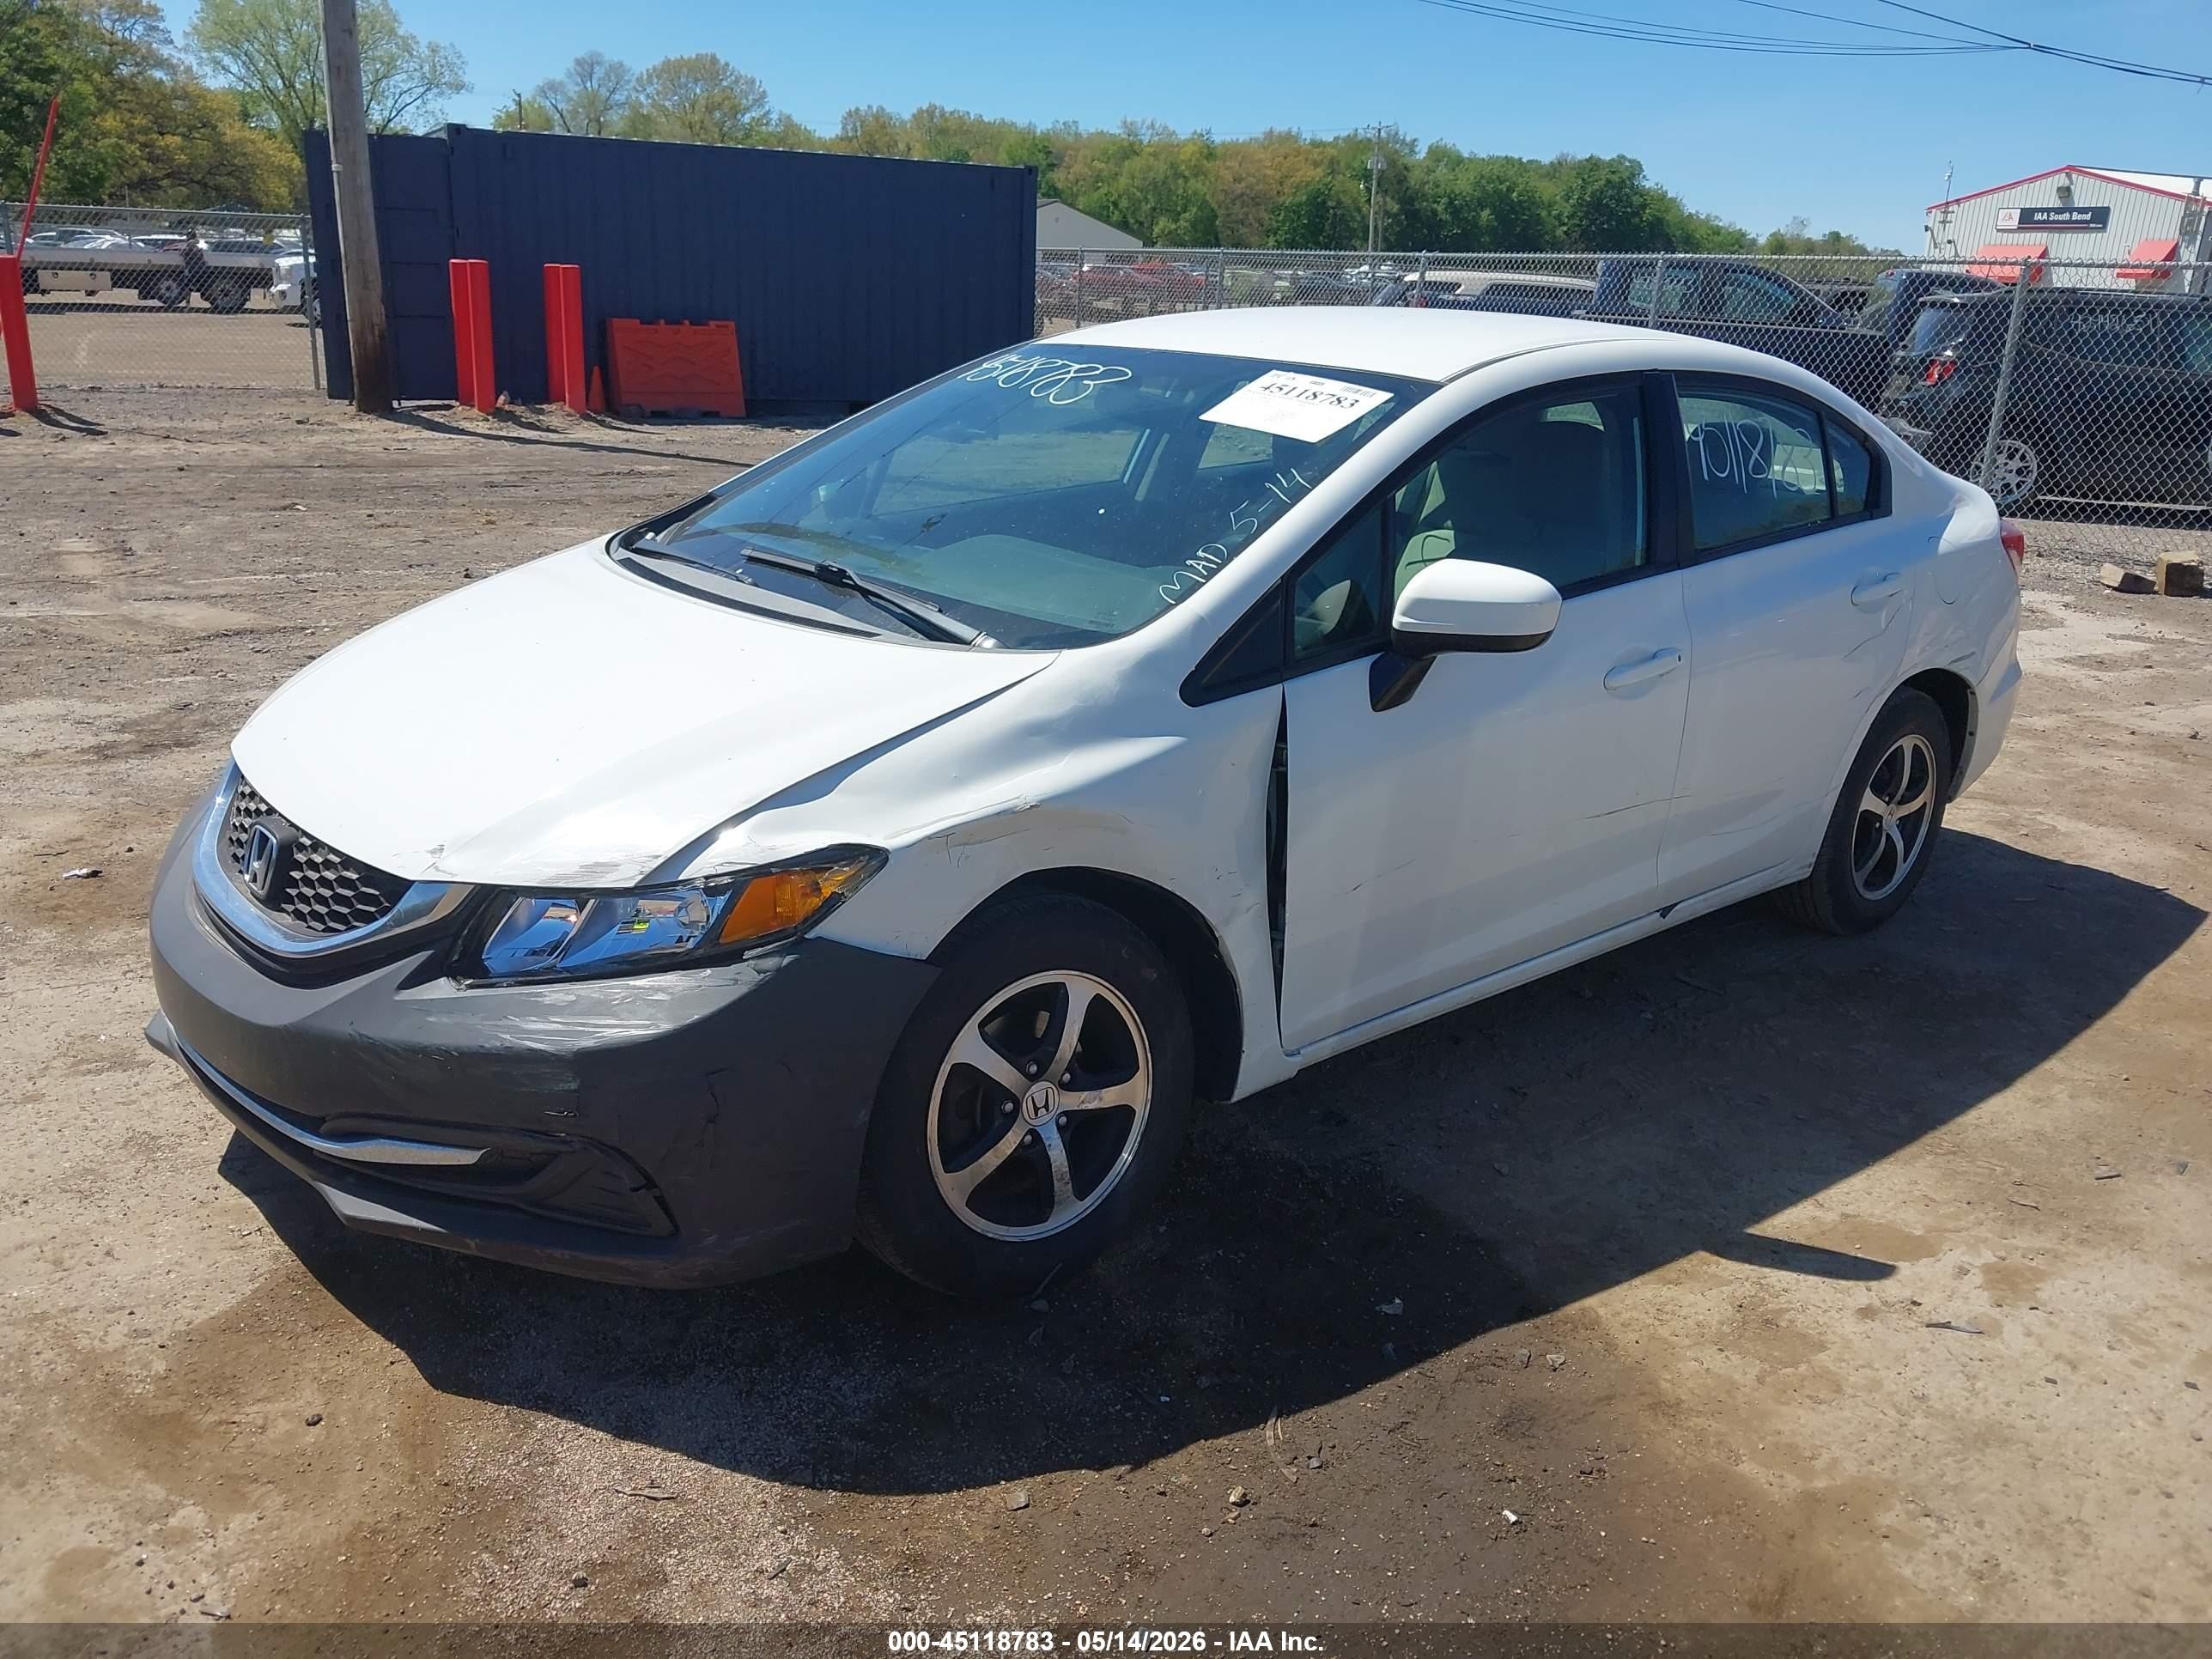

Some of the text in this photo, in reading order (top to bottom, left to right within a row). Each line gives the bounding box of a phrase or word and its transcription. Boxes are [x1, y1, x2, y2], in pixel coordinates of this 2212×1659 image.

[2033, 211, 2092, 221] IAA South Bend
[1259, 382, 1360, 410] 45118783
[1158, 467, 1314, 605] MAD 5-14
